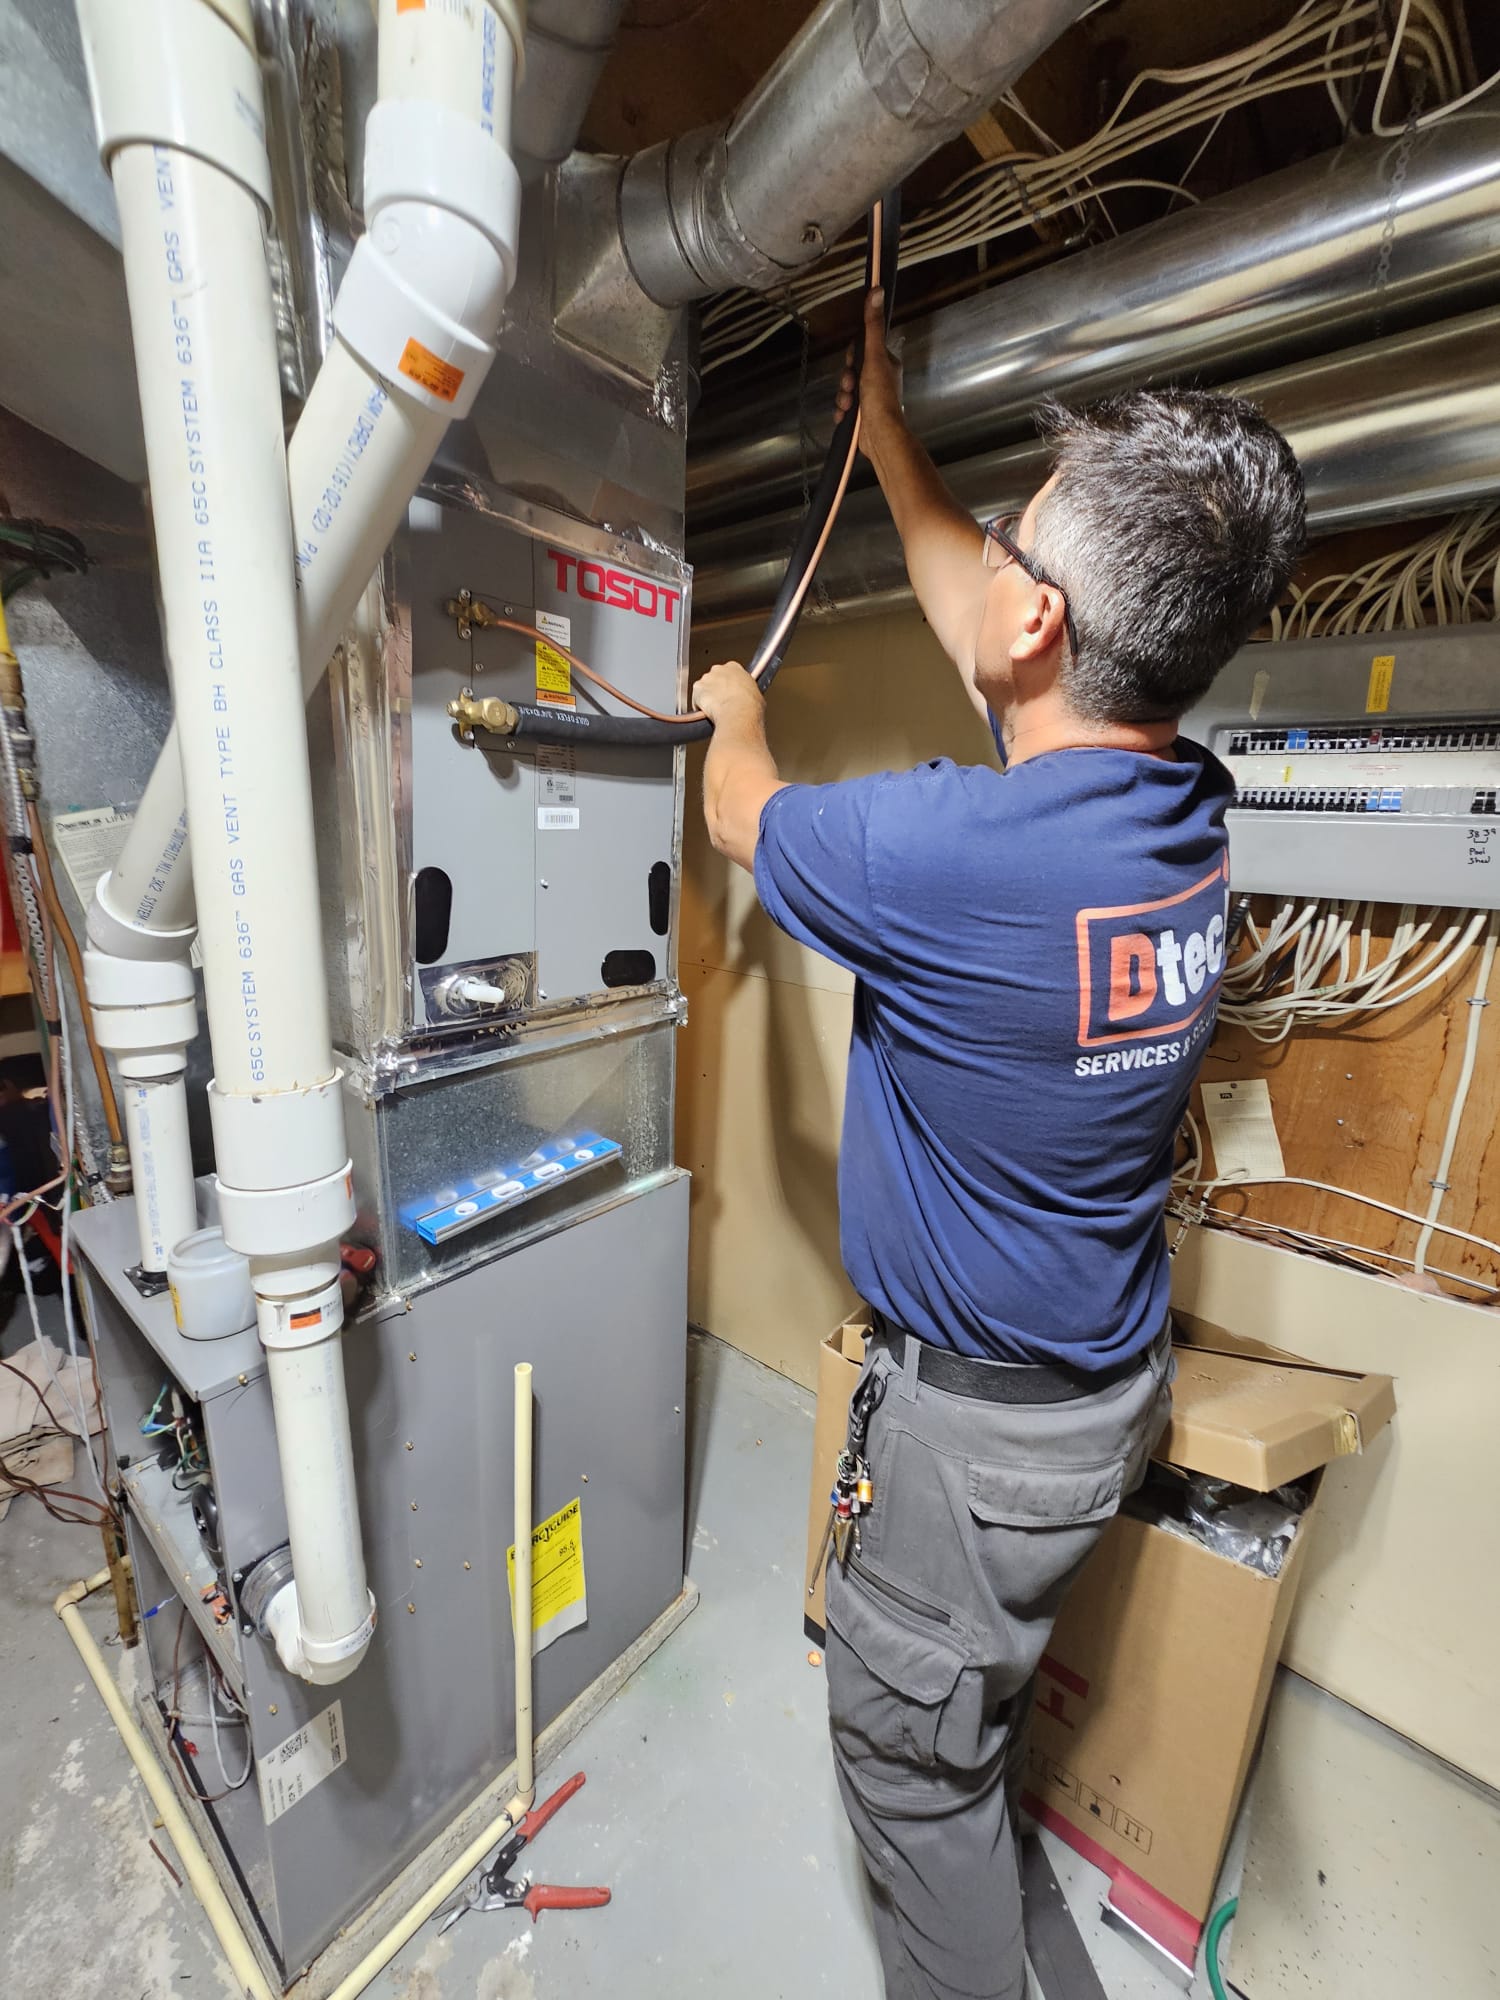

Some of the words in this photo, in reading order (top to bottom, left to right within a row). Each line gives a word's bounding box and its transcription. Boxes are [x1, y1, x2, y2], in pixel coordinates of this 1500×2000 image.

[164, 231, 184, 284] GAS
[181, 379, 205, 475] SYSTEM
[191, 480, 210, 525] 65C
[547, 548, 680, 623] TOSOT
[203, 599, 224, 670] CLASS
[212, 684, 228, 712] BH
[215, 725, 234, 779] TYPE
[222, 793, 241, 845] VENT
[1466, 829, 1480, 839] 38
[229, 857, 246, 896] GAS
[241, 970, 261, 1041] SYSTEM
[250, 1047, 265, 1082] 65C
[1074, 1041, 1182, 1077] SERVICES
